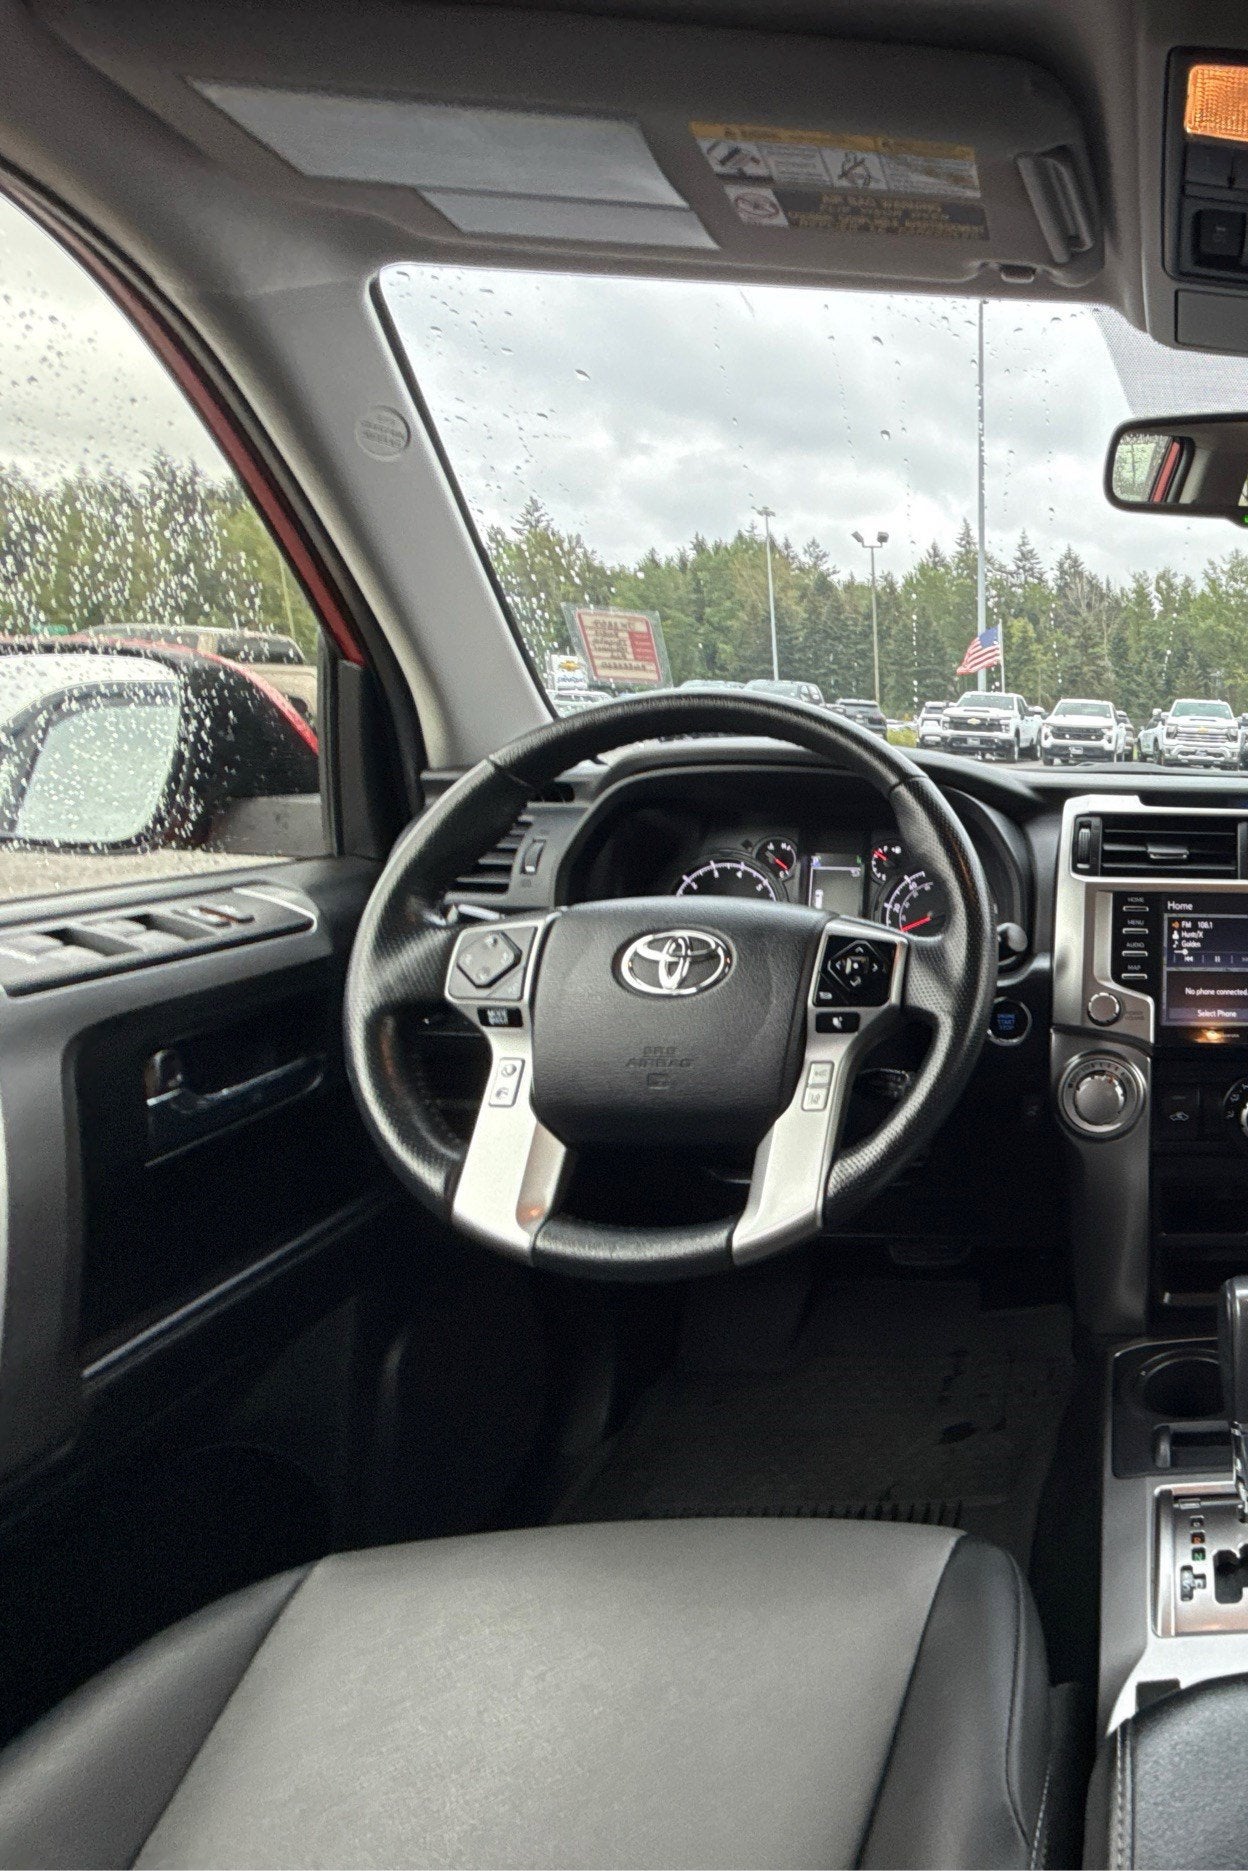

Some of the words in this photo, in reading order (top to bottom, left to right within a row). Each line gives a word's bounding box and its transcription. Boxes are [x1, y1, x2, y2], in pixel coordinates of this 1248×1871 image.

[1167, 901, 1194, 911] Home
[1181, 921, 1192, 929] FM
[1126, 941, 1146, 949] AUDIO
[1185, 987, 1196, 995] No
[1196, 987, 1216, 997] phone
[1197, 1009, 1216, 1018] Select
[1217, 1009, 1238, 1018] Phone
